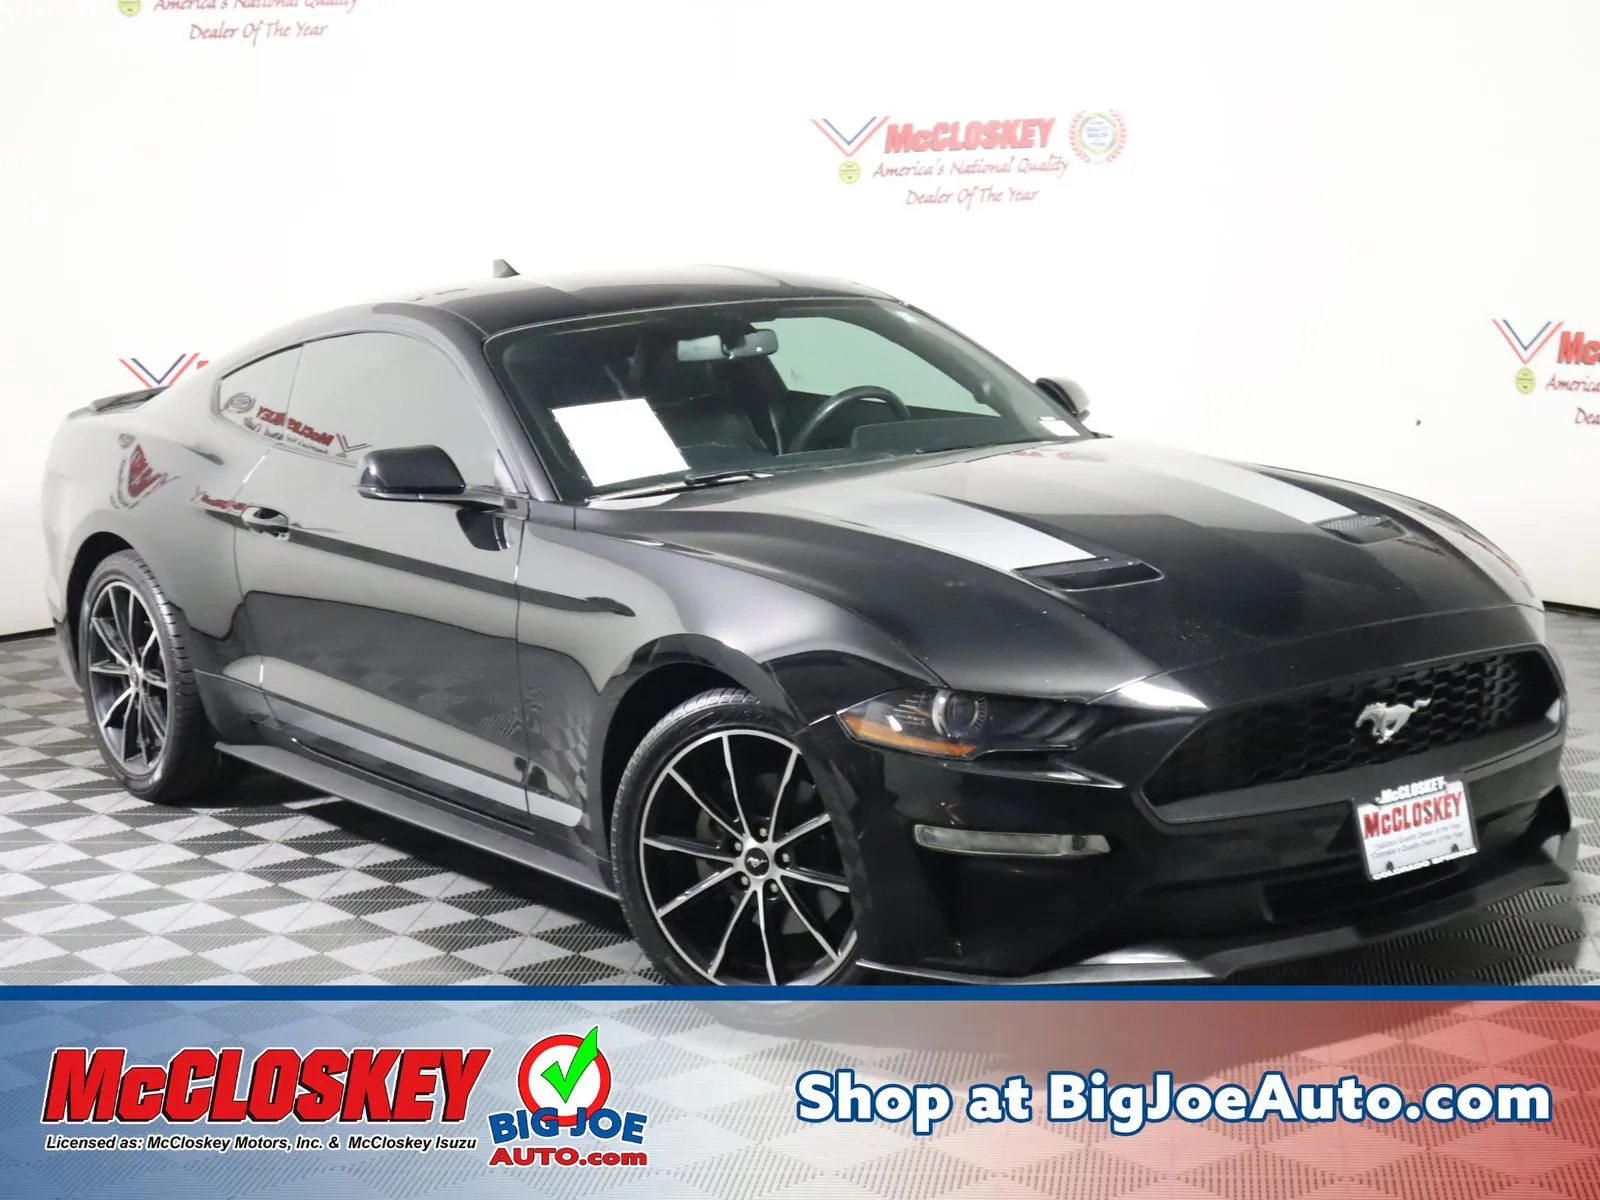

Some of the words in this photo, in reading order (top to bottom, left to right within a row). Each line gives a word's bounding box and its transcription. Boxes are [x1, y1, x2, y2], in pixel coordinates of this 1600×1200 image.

[190, 21, 239, 40] Dealer
[242, 20, 265, 46] Of
[265, 20, 292, 37] The
[296, 21, 328, 37] Year
[884, 118, 1055, 153] McCLOSKEY
[873, 158, 944, 178] America's
[949, 155, 1012, 175] National
[1017, 154, 1070, 179] Quality
[905, 186, 953, 206] Dealer
[957, 186, 979, 211] Of
[979, 187, 1004, 203] The
[1008, 187, 1040, 203] Year
[1364, 792, 1462, 839] McCLOSKEY
